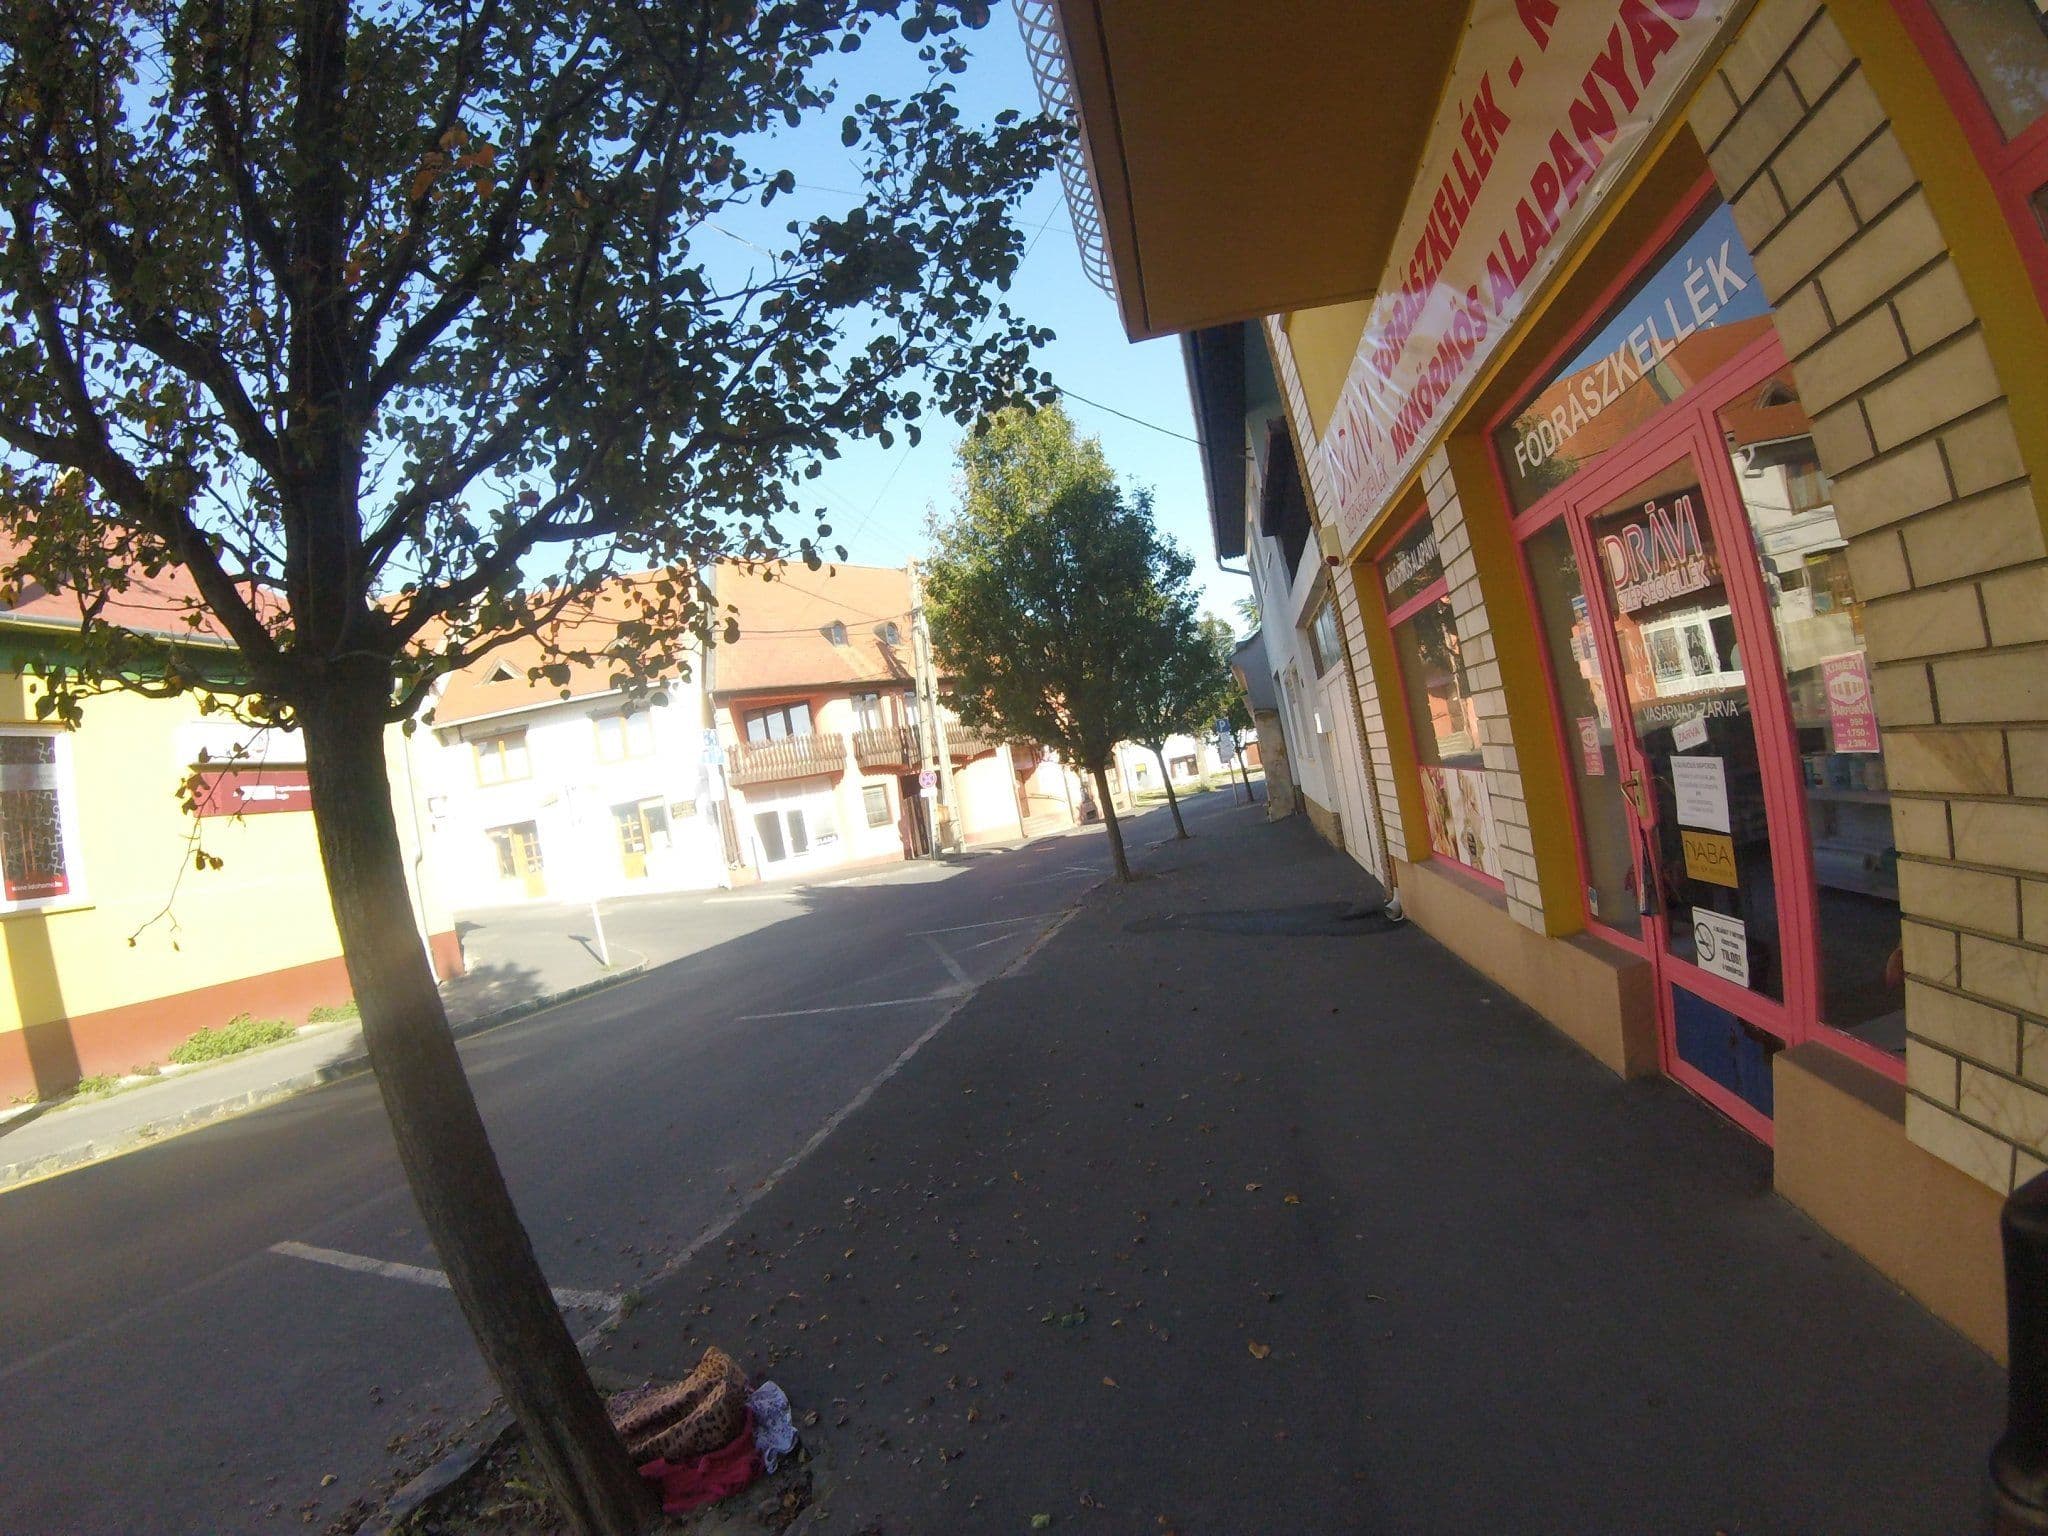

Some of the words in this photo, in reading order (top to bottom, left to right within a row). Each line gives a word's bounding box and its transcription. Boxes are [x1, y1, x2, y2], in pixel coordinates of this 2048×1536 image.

[1486, 0, 1700, 317] ALAPANYA
[1514, 238, 1748, 479] FODRÁSZKELLÉK
[1617, 560, 1711, 613] SZÉPSÉGKELLÉK
[1700, 697, 1740, 719] ZÁRVA
